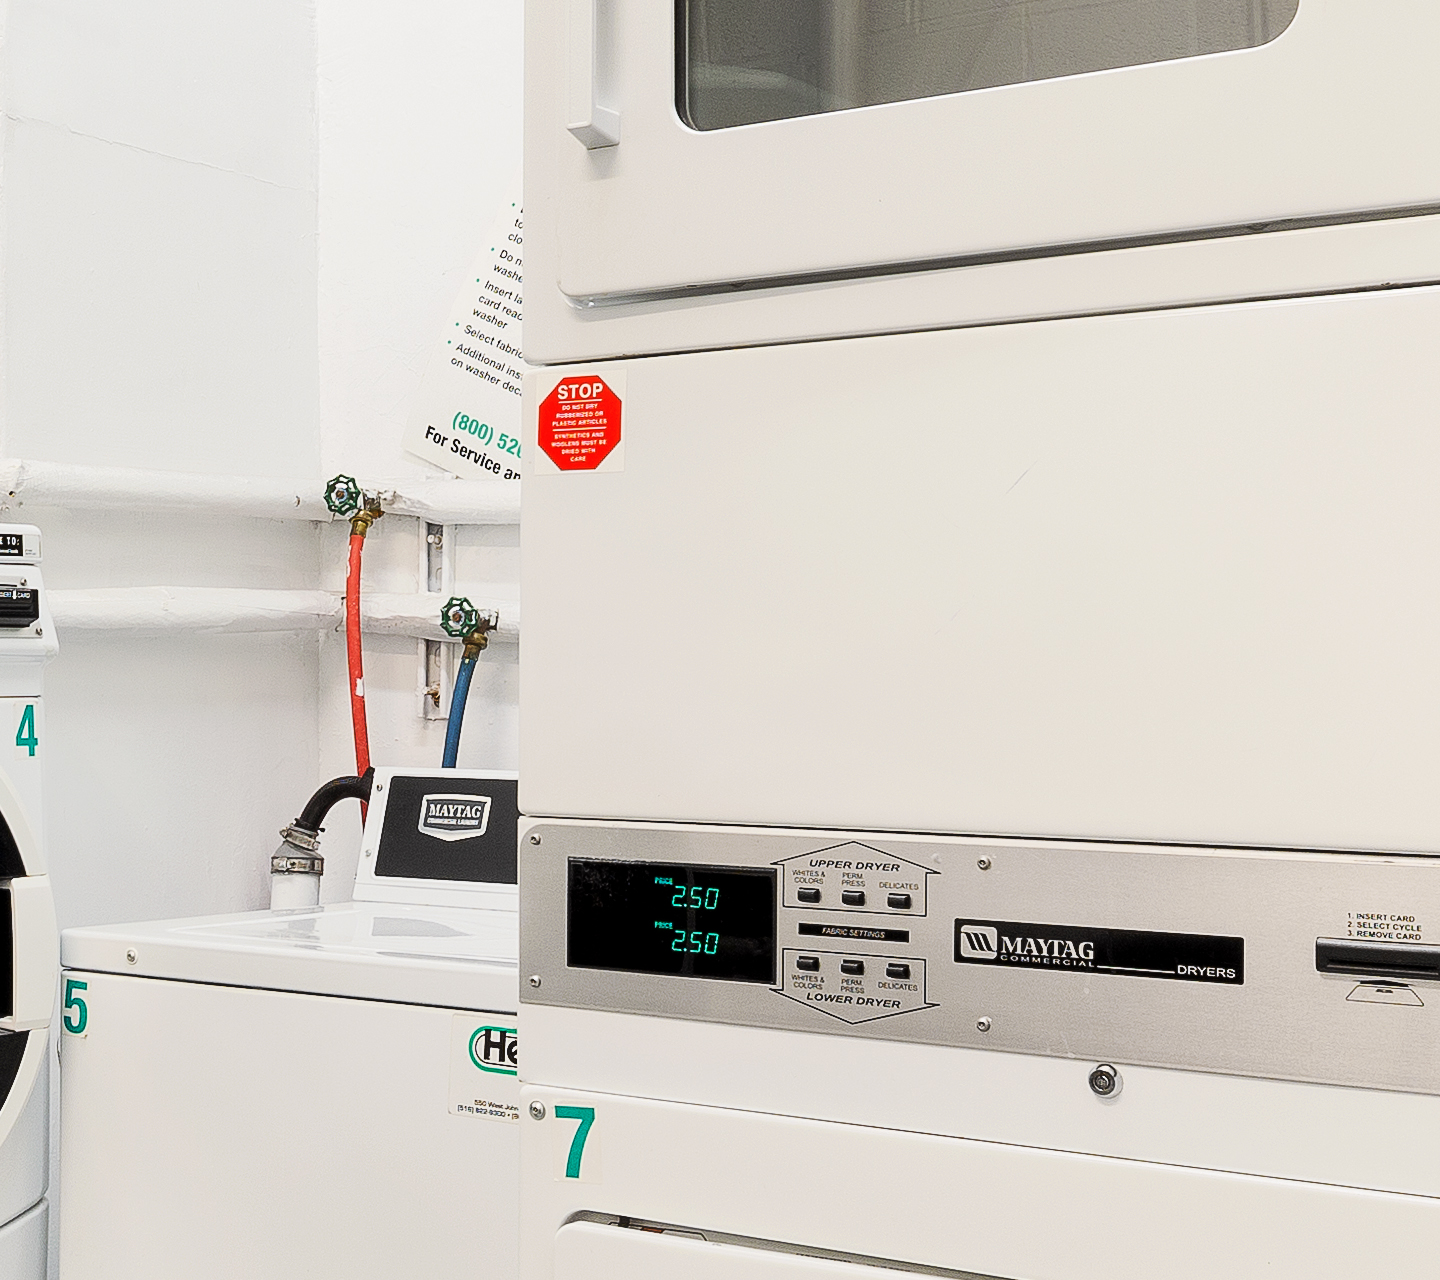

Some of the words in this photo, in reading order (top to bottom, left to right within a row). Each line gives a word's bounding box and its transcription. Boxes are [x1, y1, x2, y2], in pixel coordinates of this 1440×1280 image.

[484, 280, 513, 300] Insert
[473, 308, 508, 329] washer
[464, 325, 495, 346] Select
[456, 343, 505, 371] Additional
[466, 364, 501, 385] washer
[558, 383, 603, 399] STOP
[453, 412, 494, 446] (800)
[425, 425, 448, 447] For
[451, 438, 501, 474] Service
[16, 704, 38, 757] 4
[429, 803, 482, 818] MAYTAG
[808, 858, 851, 870] UPPER
[854, 860, 901, 873] DRYER
[671, 886, 720, 911] 2.50
[671, 930, 720, 956] 2.50
[1000, 936, 1096, 960] MAYTAG
[1176, 964, 1236, 979] DRYERS
[63, 979, 88, 1034] 5
[806, 992, 855, 1006] LOWER
[856, 996, 901, 1009] DRYER
[554, 1105, 596, 1179] 7
